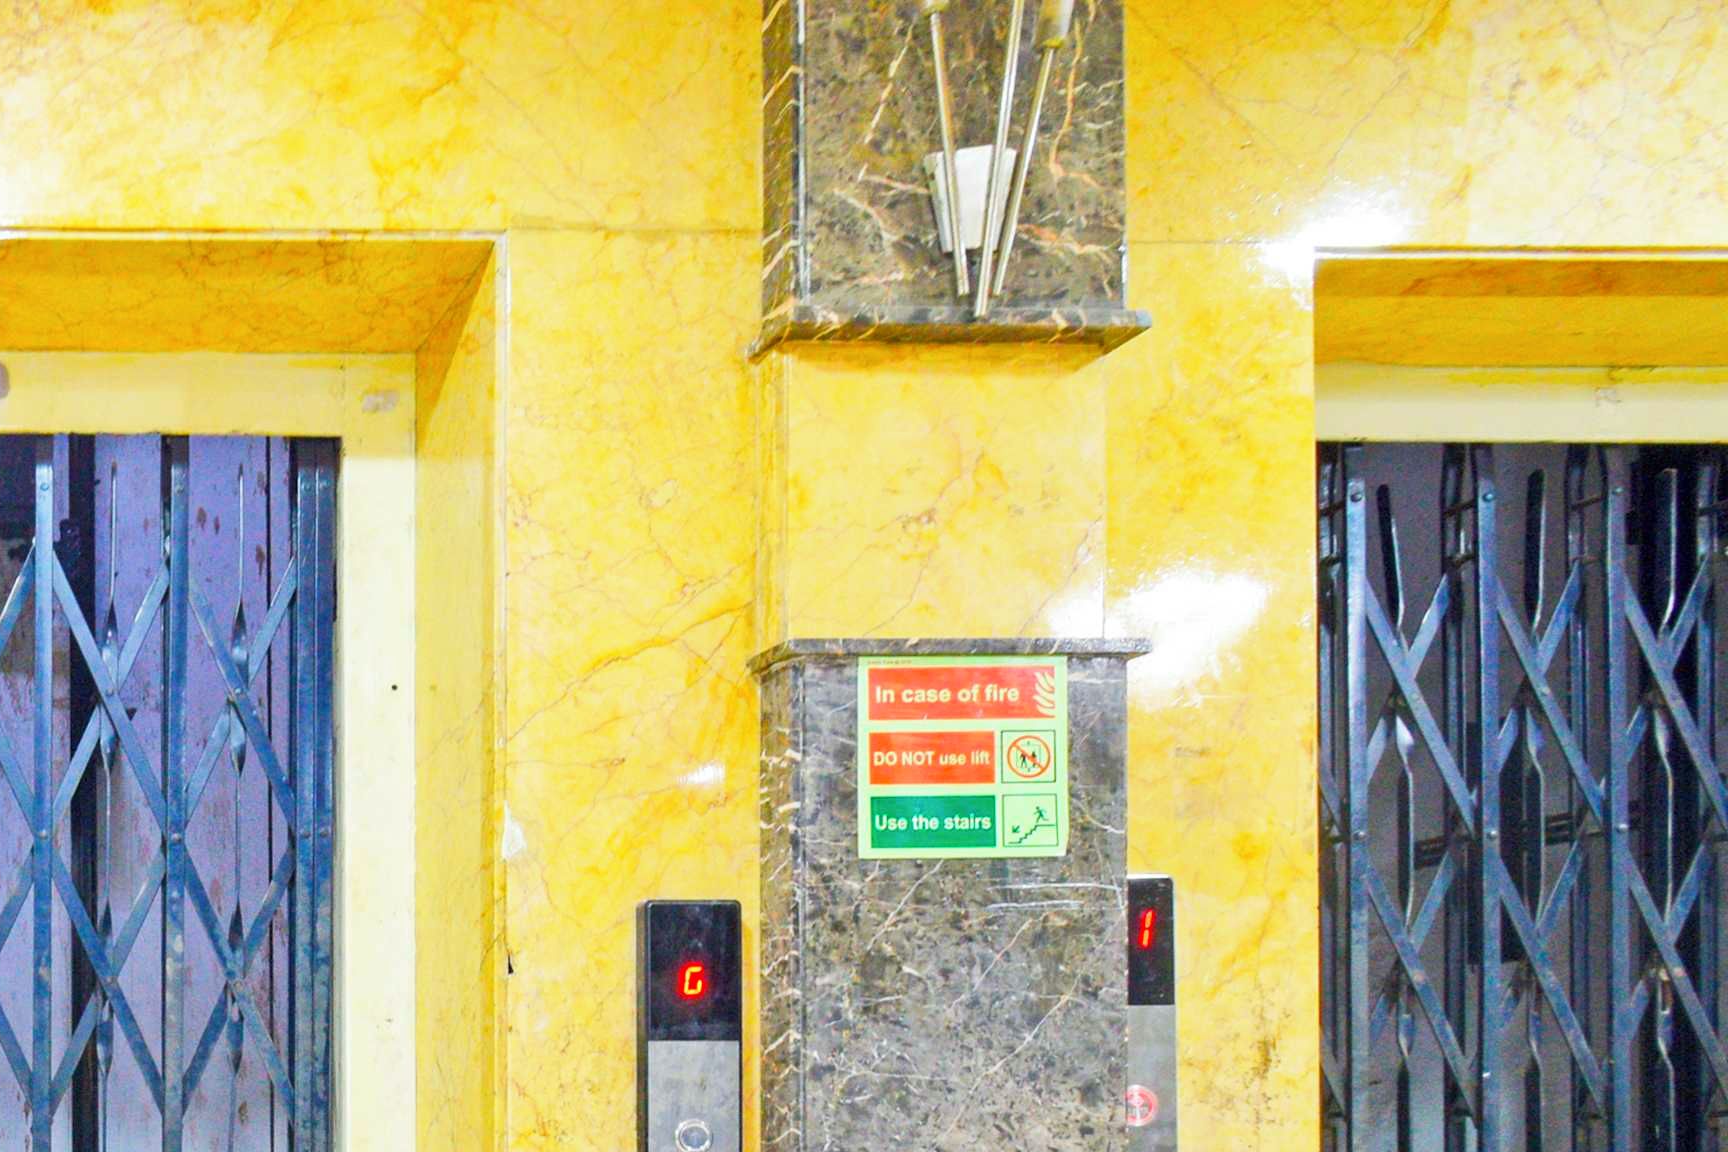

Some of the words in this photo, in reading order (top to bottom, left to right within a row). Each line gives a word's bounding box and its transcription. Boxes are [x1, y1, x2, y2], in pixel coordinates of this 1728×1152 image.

[875, 685, 895, 703] In
[901, 688, 951, 703] case
[957, 684, 980, 702] of
[984, 684, 1020, 702] fire
[873, 751, 897, 766] DO
[901, 751, 935, 766] NOT
[939, 753, 967, 766] use
[970, 750, 991, 765] lift
[875, 814, 908, 831] Use
[912, 814, 939, 831] the
[943, 813, 992, 830] stairs
[1141, 908, 1154, 948] 1
[682, 965, 703, 995] G
